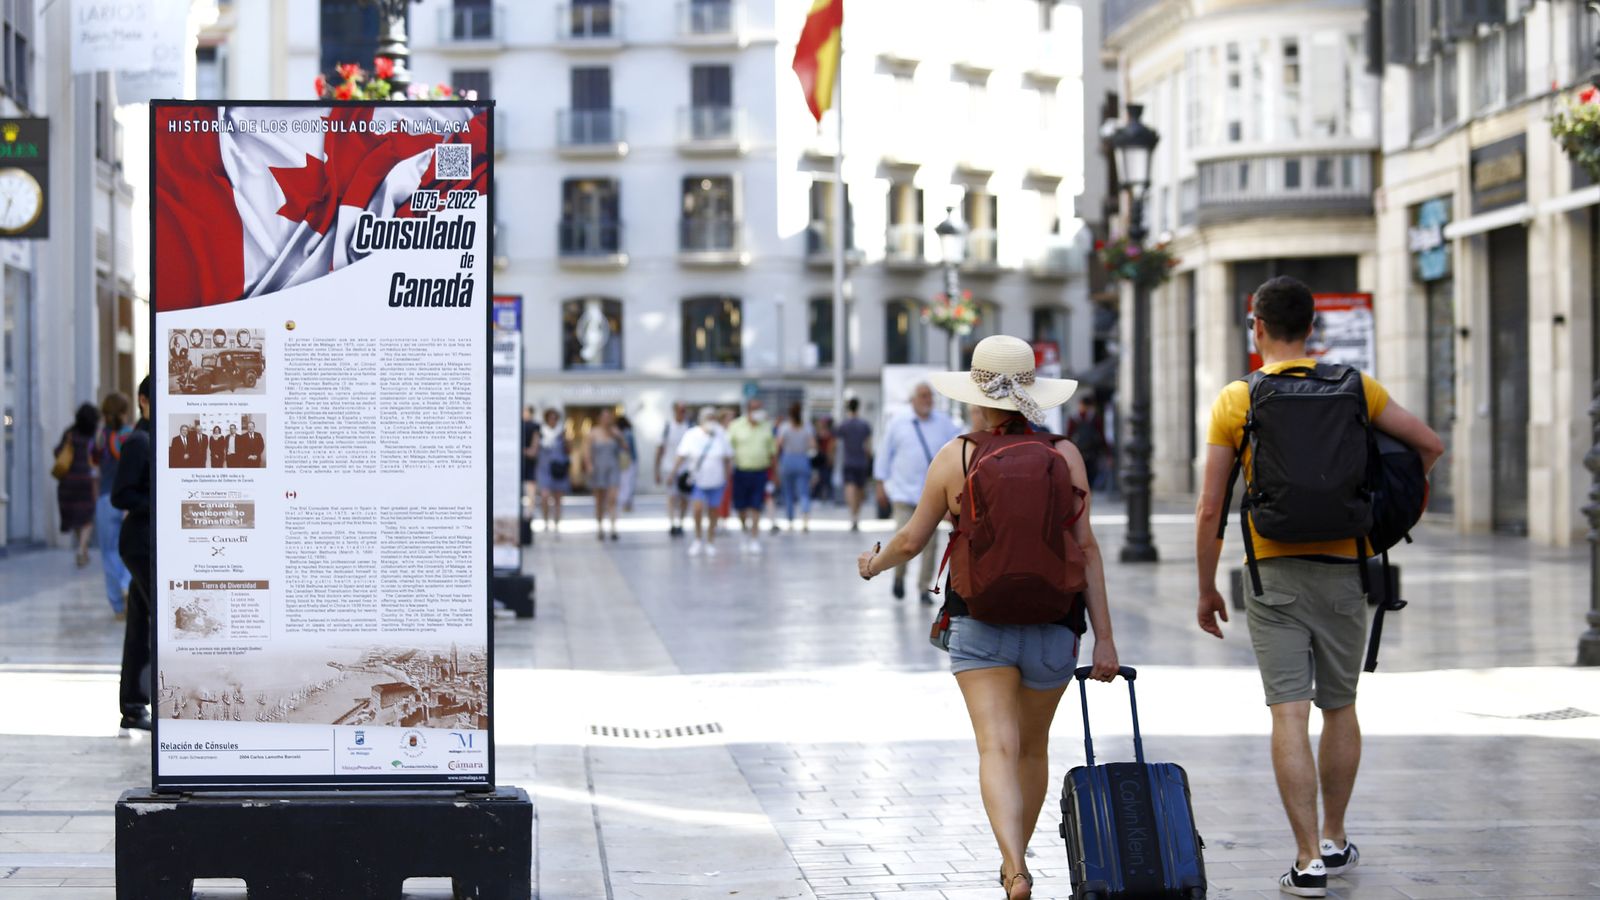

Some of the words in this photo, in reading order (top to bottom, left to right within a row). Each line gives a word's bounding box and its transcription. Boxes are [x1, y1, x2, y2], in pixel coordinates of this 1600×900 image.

[168, 120, 234, 133] HISTORIA
[238, 120, 255, 133] DE
[260, 120, 287, 133] LOS
[292, 120, 386, 133] CONSULADOS
[391, 120, 408, 133] EN
[413, 118, 470, 133] MÁLAGA
[357, 215, 475, 250] Consulado
[460, 253, 473, 268] de
[388, 272, 474, 307] Canadá
[161, 741, 192, 749] Relación
[205, 741, 239, 749] Cónsules
[448, 761, 483, 770] Cámara
[1120, 780, 1144, 824] Calvin
[1128, 828, 1151, 864] Klein
